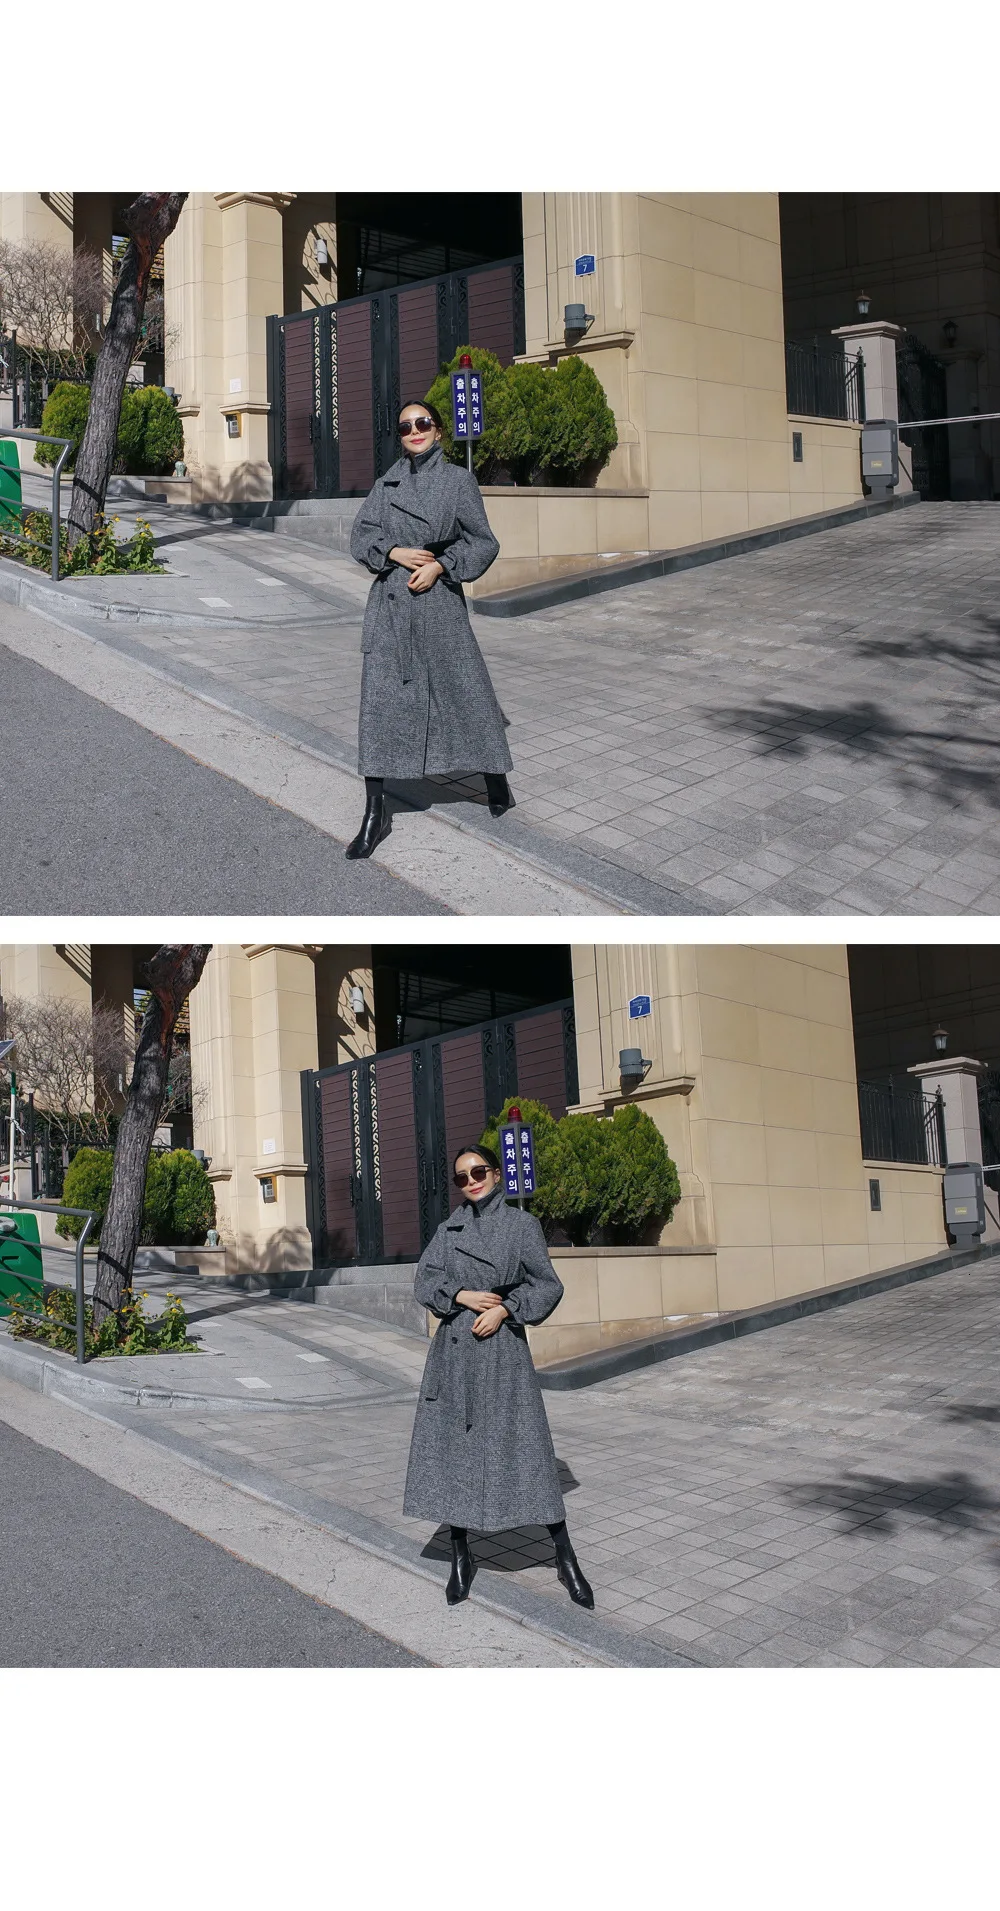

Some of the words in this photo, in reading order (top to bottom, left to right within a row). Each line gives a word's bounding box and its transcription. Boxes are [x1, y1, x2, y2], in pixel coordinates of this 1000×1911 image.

[582, 264, 588, 272] 7
[456, 378, 467, 433] 출차주의
[471, 377, 480, 433] 출차주의
[637, 1005, 642, 1014] 7
[505, 1132, 517, 1192] 출차주의
[521, 1131, 532, 1190] 출차주의
